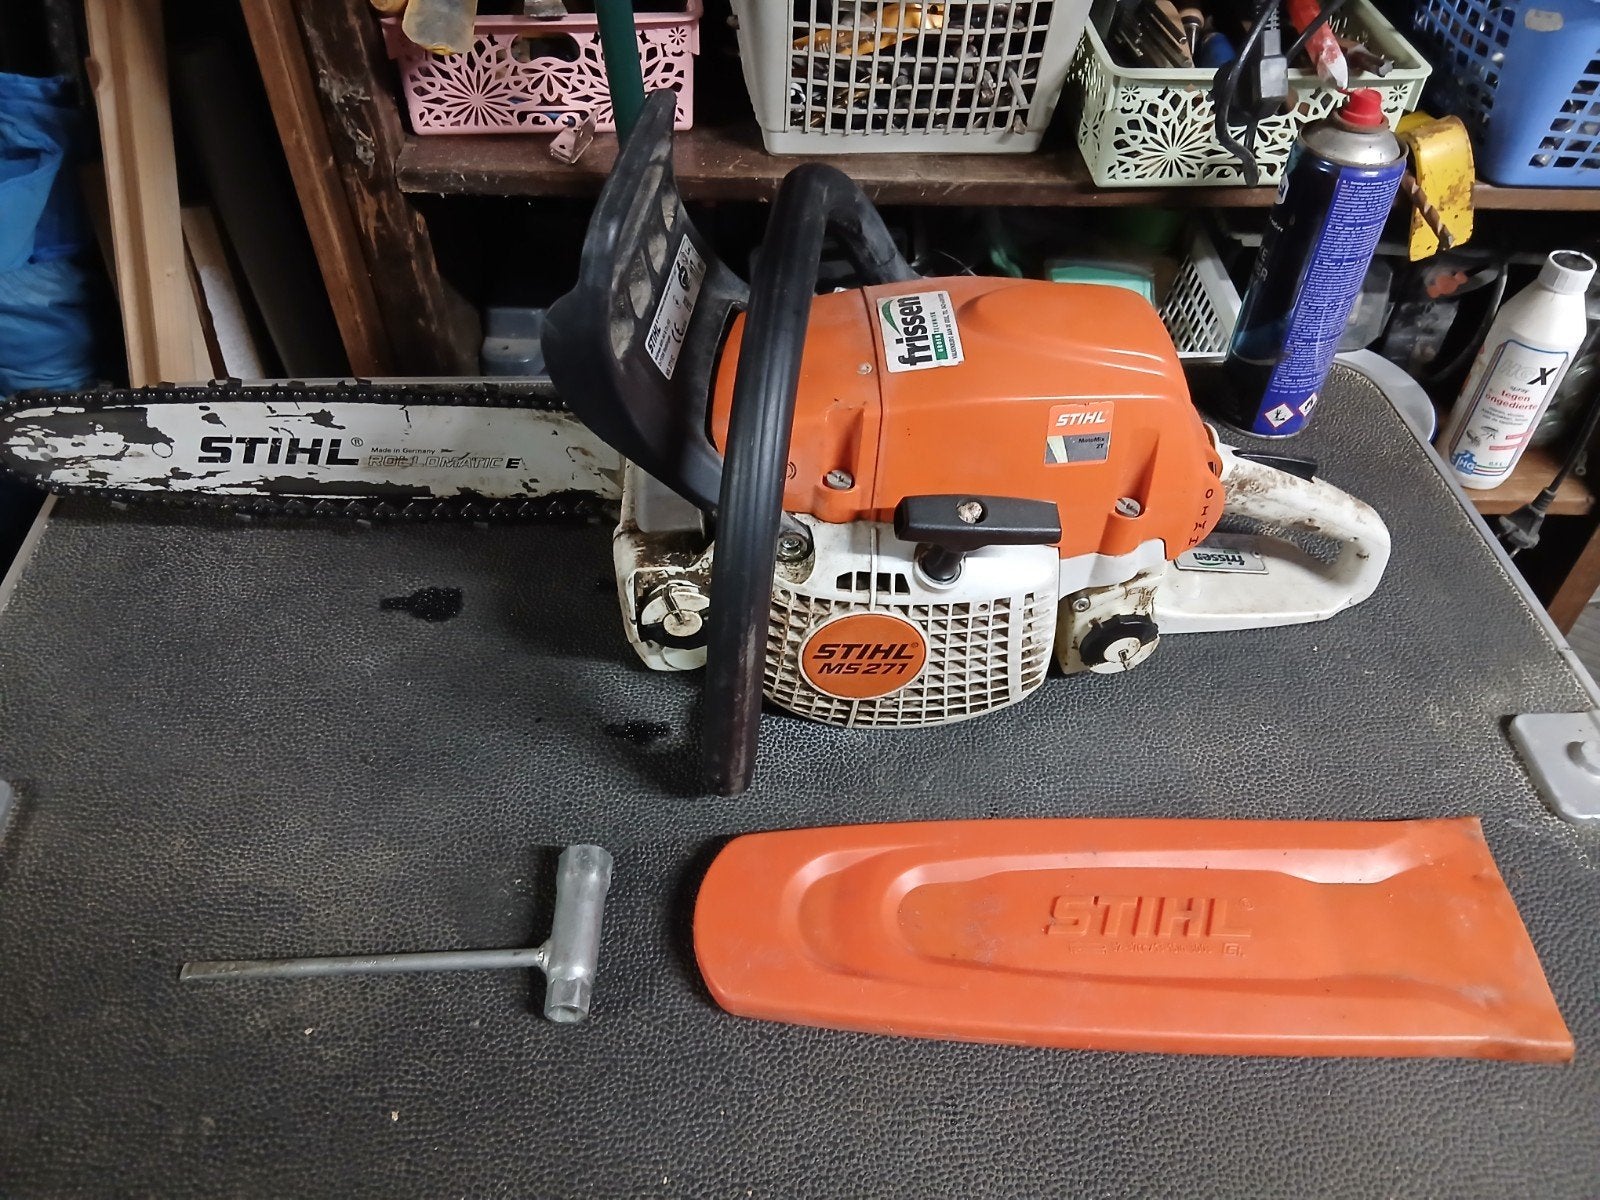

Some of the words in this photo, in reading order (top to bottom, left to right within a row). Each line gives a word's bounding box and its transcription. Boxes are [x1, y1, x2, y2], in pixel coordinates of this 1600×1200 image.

[896, 296, 933, 366] frissen
[1485, 394, 1538, 411] ongedierte
[1501, 390, 1531, 402] tegen
[1055, 411, 1106, 427] STIHL
[1192, 552, 1245, 566] frissen
[812, 643, 915, 660] STIHL
[817, 662, 863, 675] MS
[861, 662, 909, 675] 271
[1042, 895, 1252, 938] STIHL
